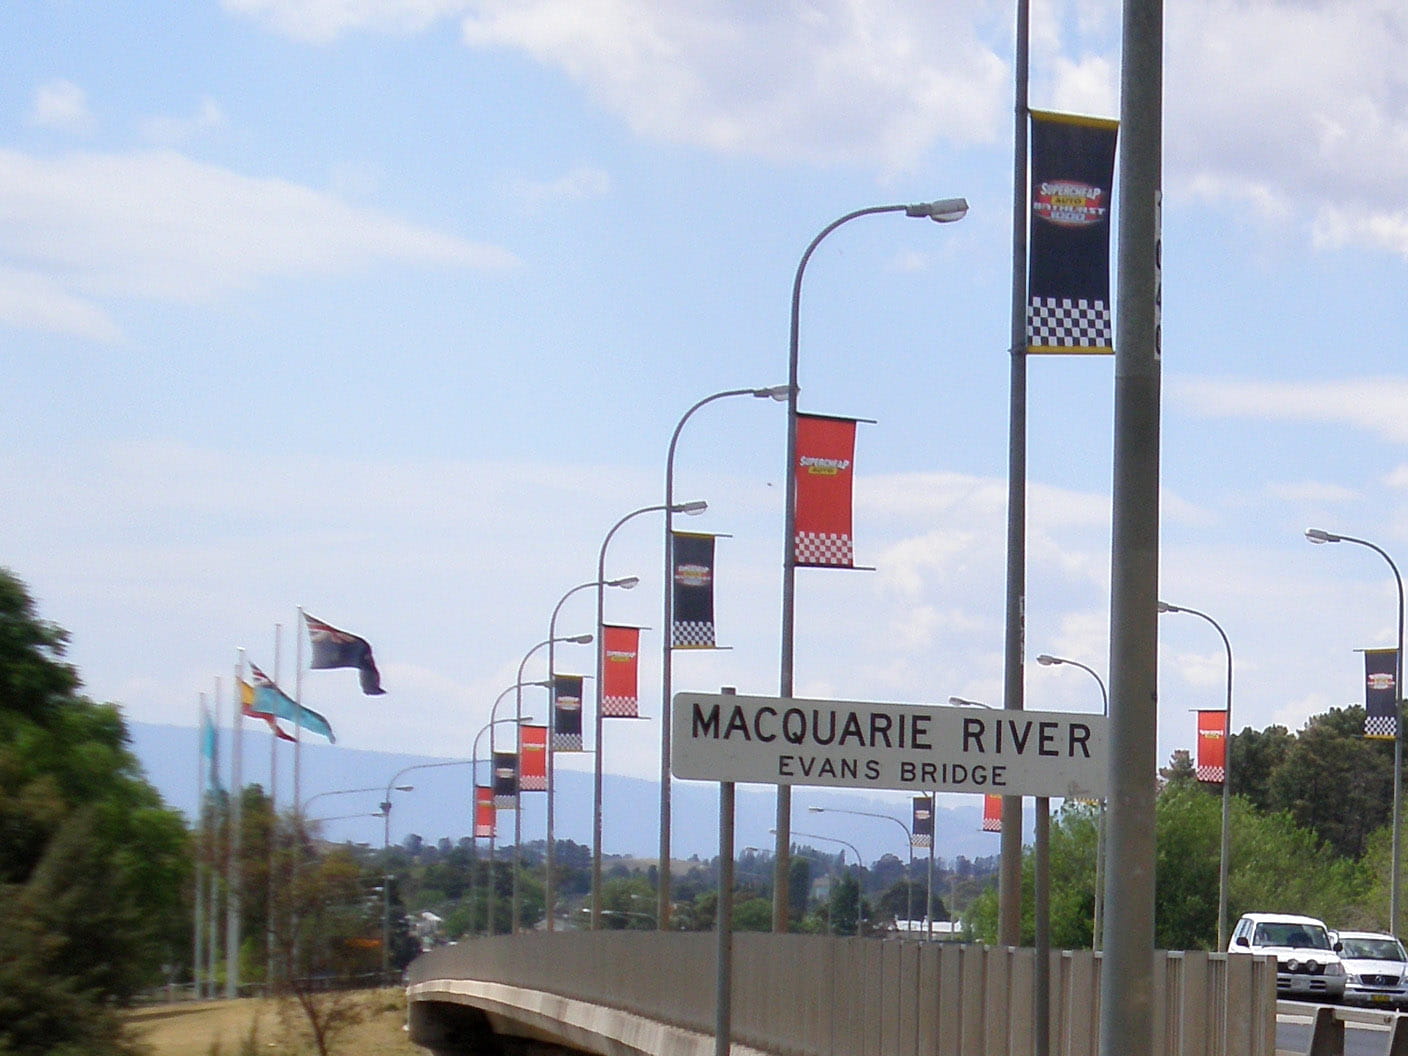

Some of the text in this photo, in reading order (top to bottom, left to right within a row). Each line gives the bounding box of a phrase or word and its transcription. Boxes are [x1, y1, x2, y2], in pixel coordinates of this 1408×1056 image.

[1040, 182, 1102, 200] SUPERCHEAP
[692, 703, 1091, 758] MACQUARIE RIVER
[779, 756, 1007, 787] EVANS BRIDGE
